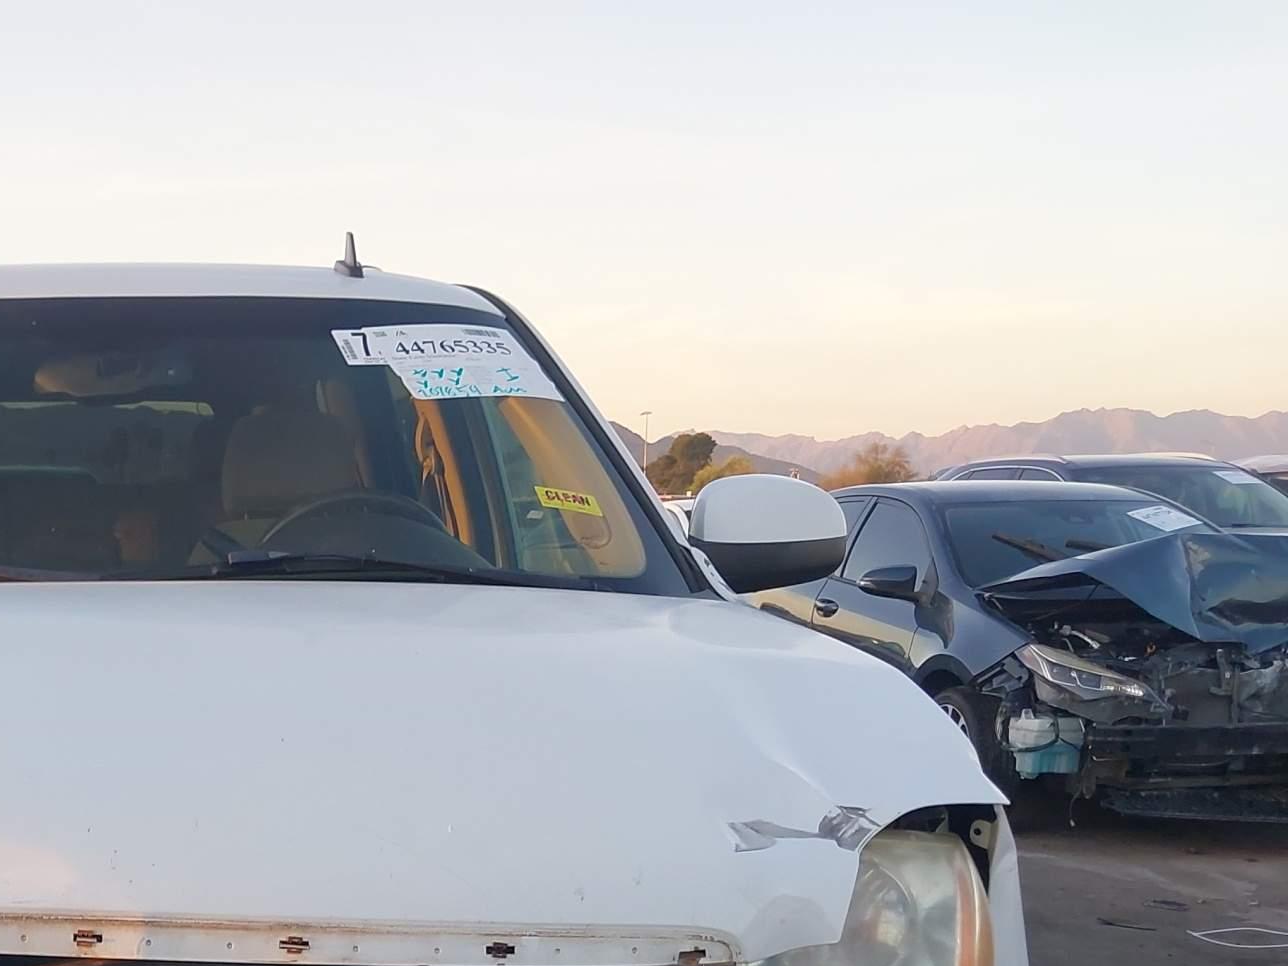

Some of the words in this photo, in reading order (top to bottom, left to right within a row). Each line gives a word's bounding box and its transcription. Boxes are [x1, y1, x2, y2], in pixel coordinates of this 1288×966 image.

[350, 332, 371, 357] 7
[394, 339, 512, 356] 44765335
[544, 489, 592, 507] CLEAN
